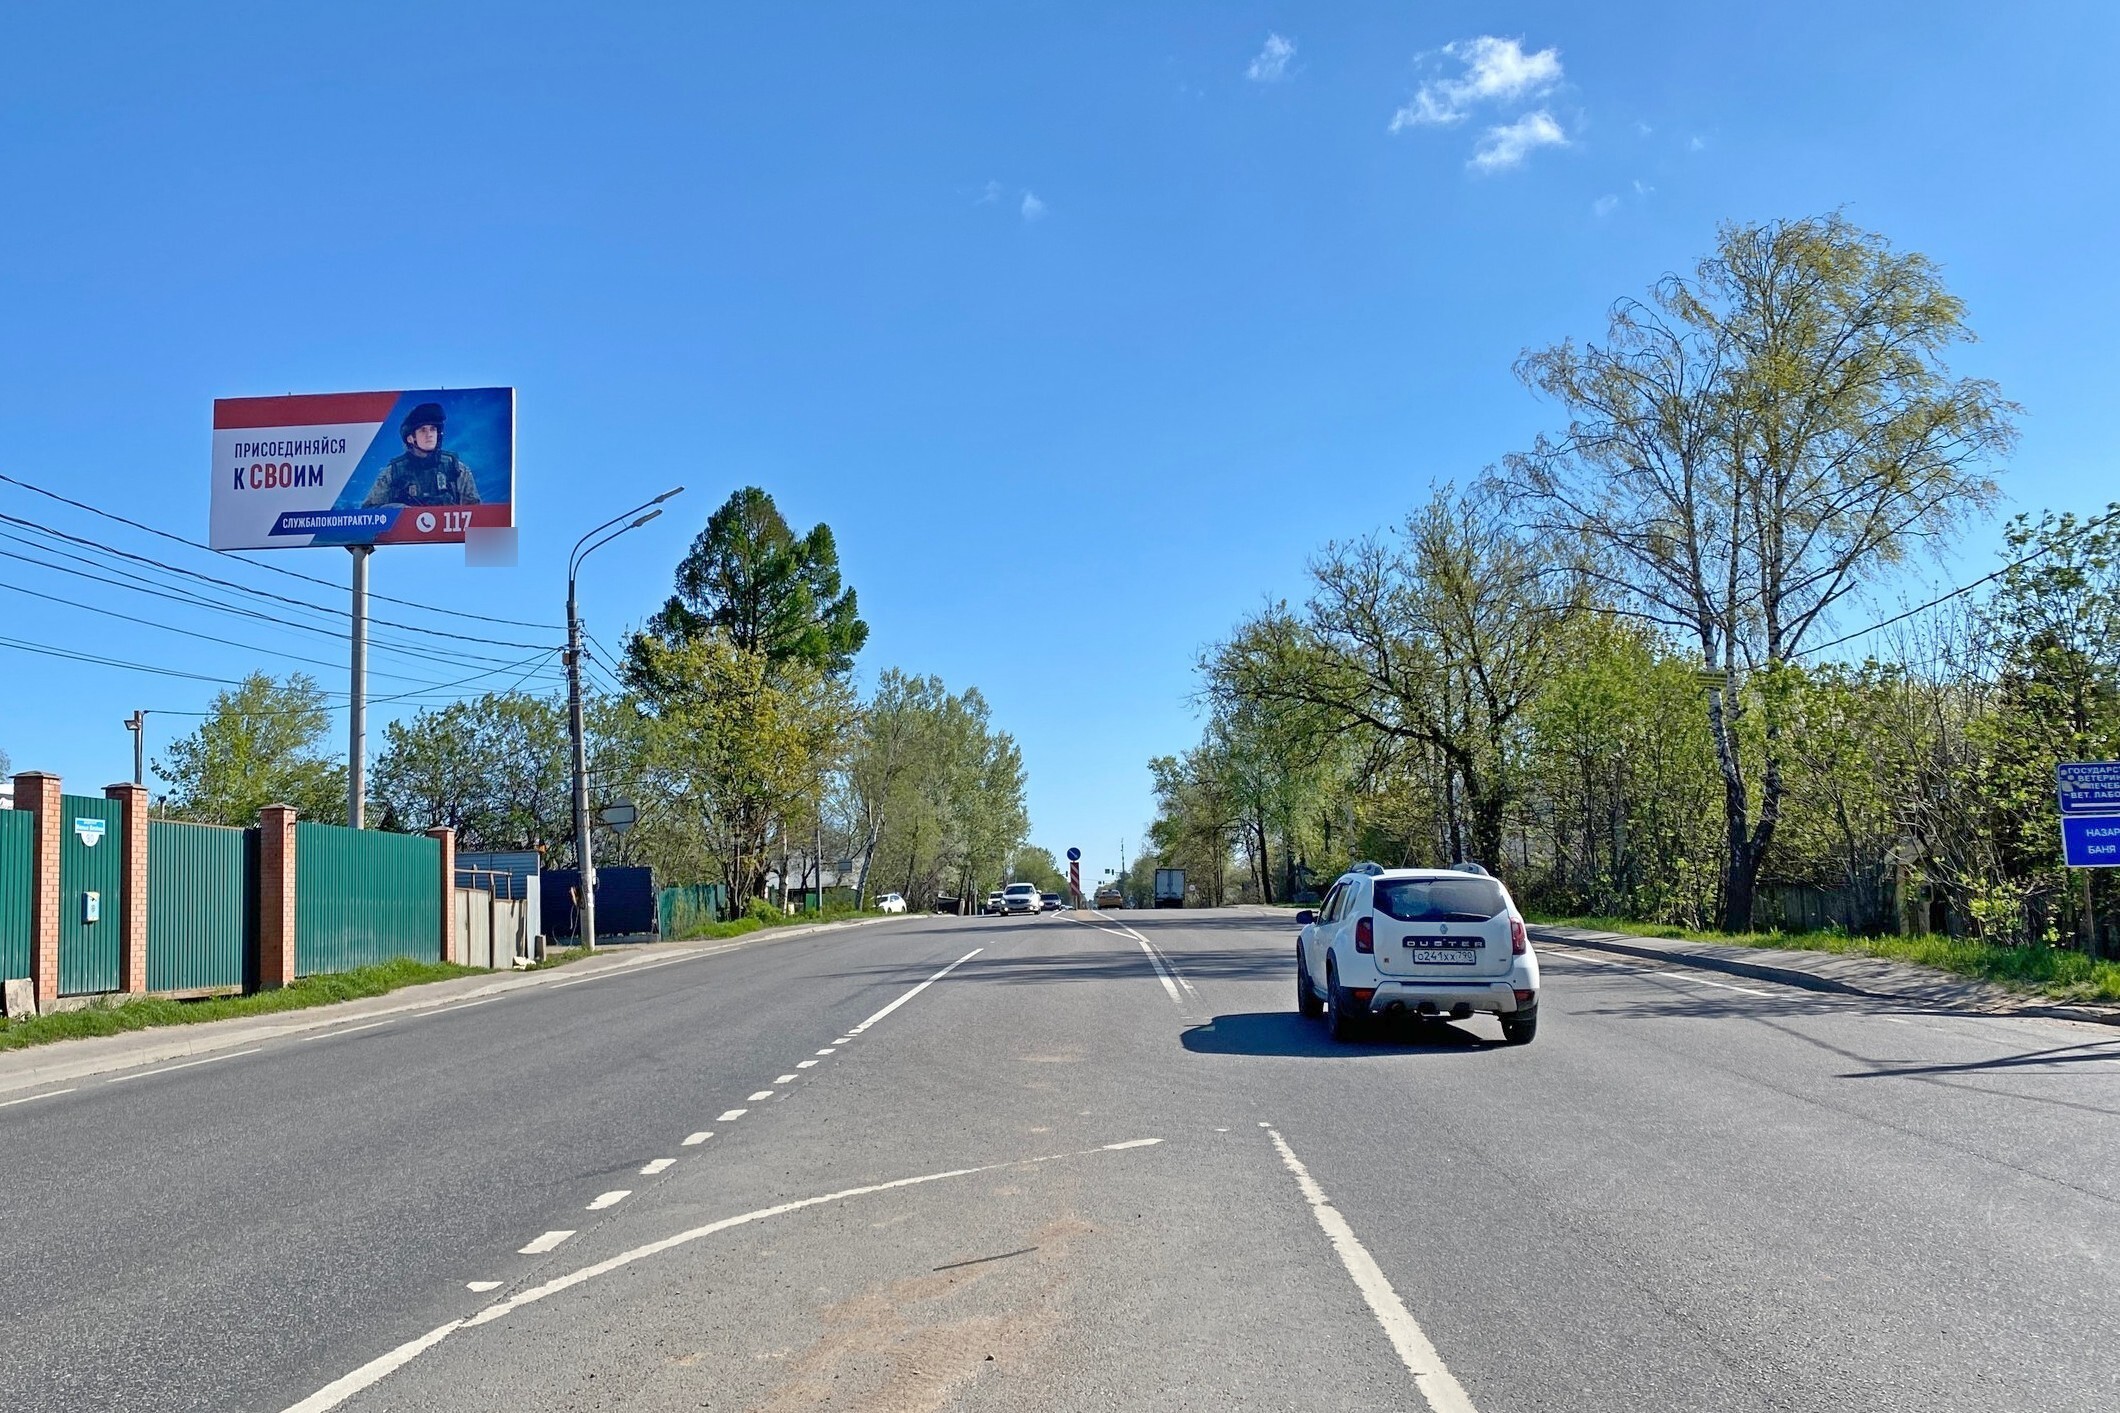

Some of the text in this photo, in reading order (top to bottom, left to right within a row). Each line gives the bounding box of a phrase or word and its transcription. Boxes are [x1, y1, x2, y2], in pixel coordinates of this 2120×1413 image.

[234, 436, 346, 459] ПРИСОЕДИНЯЙСЯ
[233, 467, 245, 490] К
[282, 513, 387, 529] СЛУЖБАПОКОНТРАКТУ.РФ
[443, 511, 473, 533] 117
[2067, 766, 2120, 775] ГОСУДАРС
[2088, 845, 2116, 854] БАНЯ
